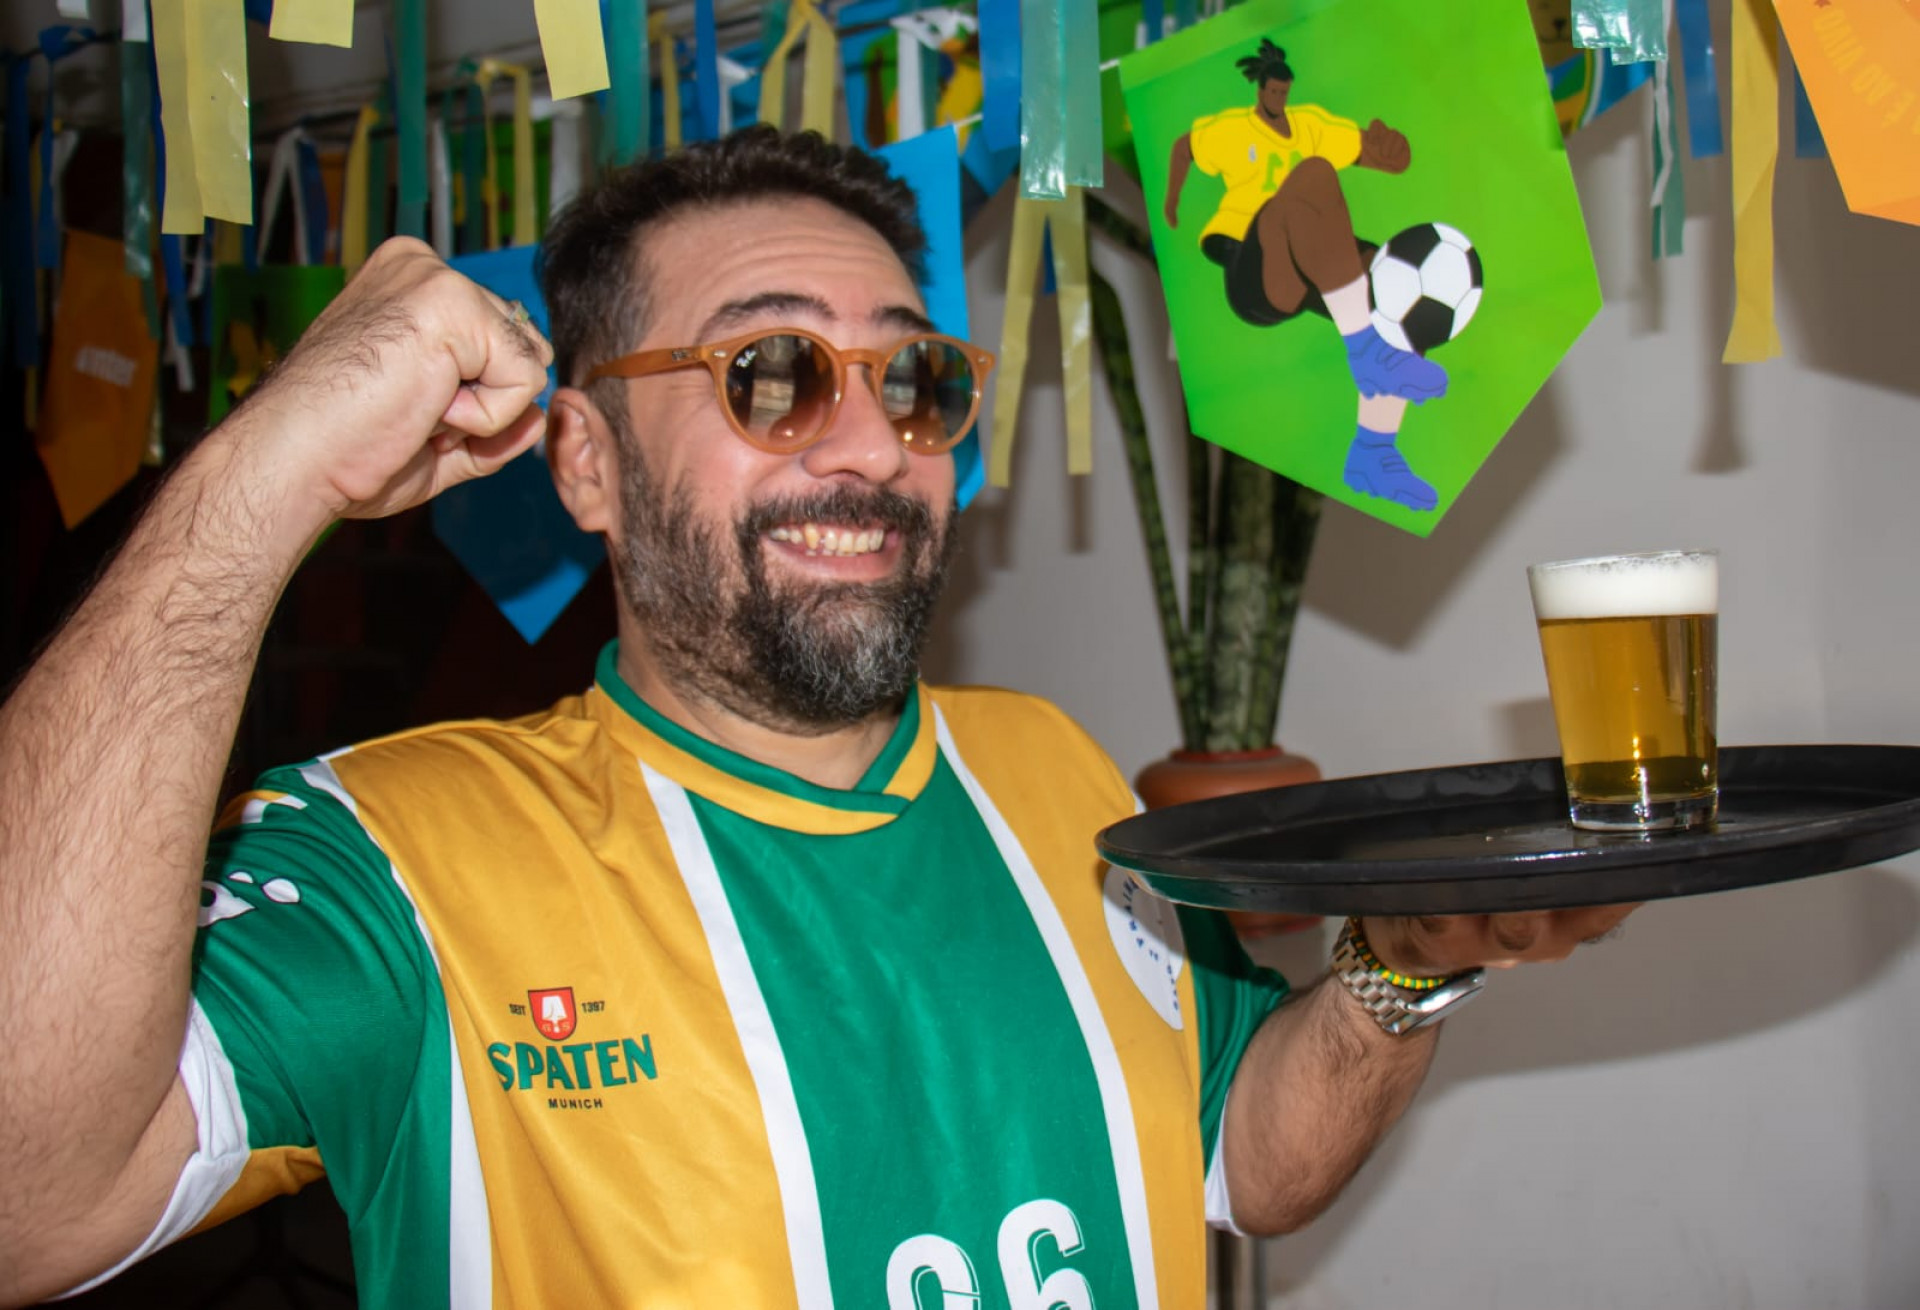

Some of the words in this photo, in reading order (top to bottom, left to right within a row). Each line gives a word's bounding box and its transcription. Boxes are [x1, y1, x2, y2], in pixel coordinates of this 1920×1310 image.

[581, 1001, 605, 1014] 1397
[487, 1033, 658, 1091] SPATEN
[549, 1098, 603, 1109] MUNICH
